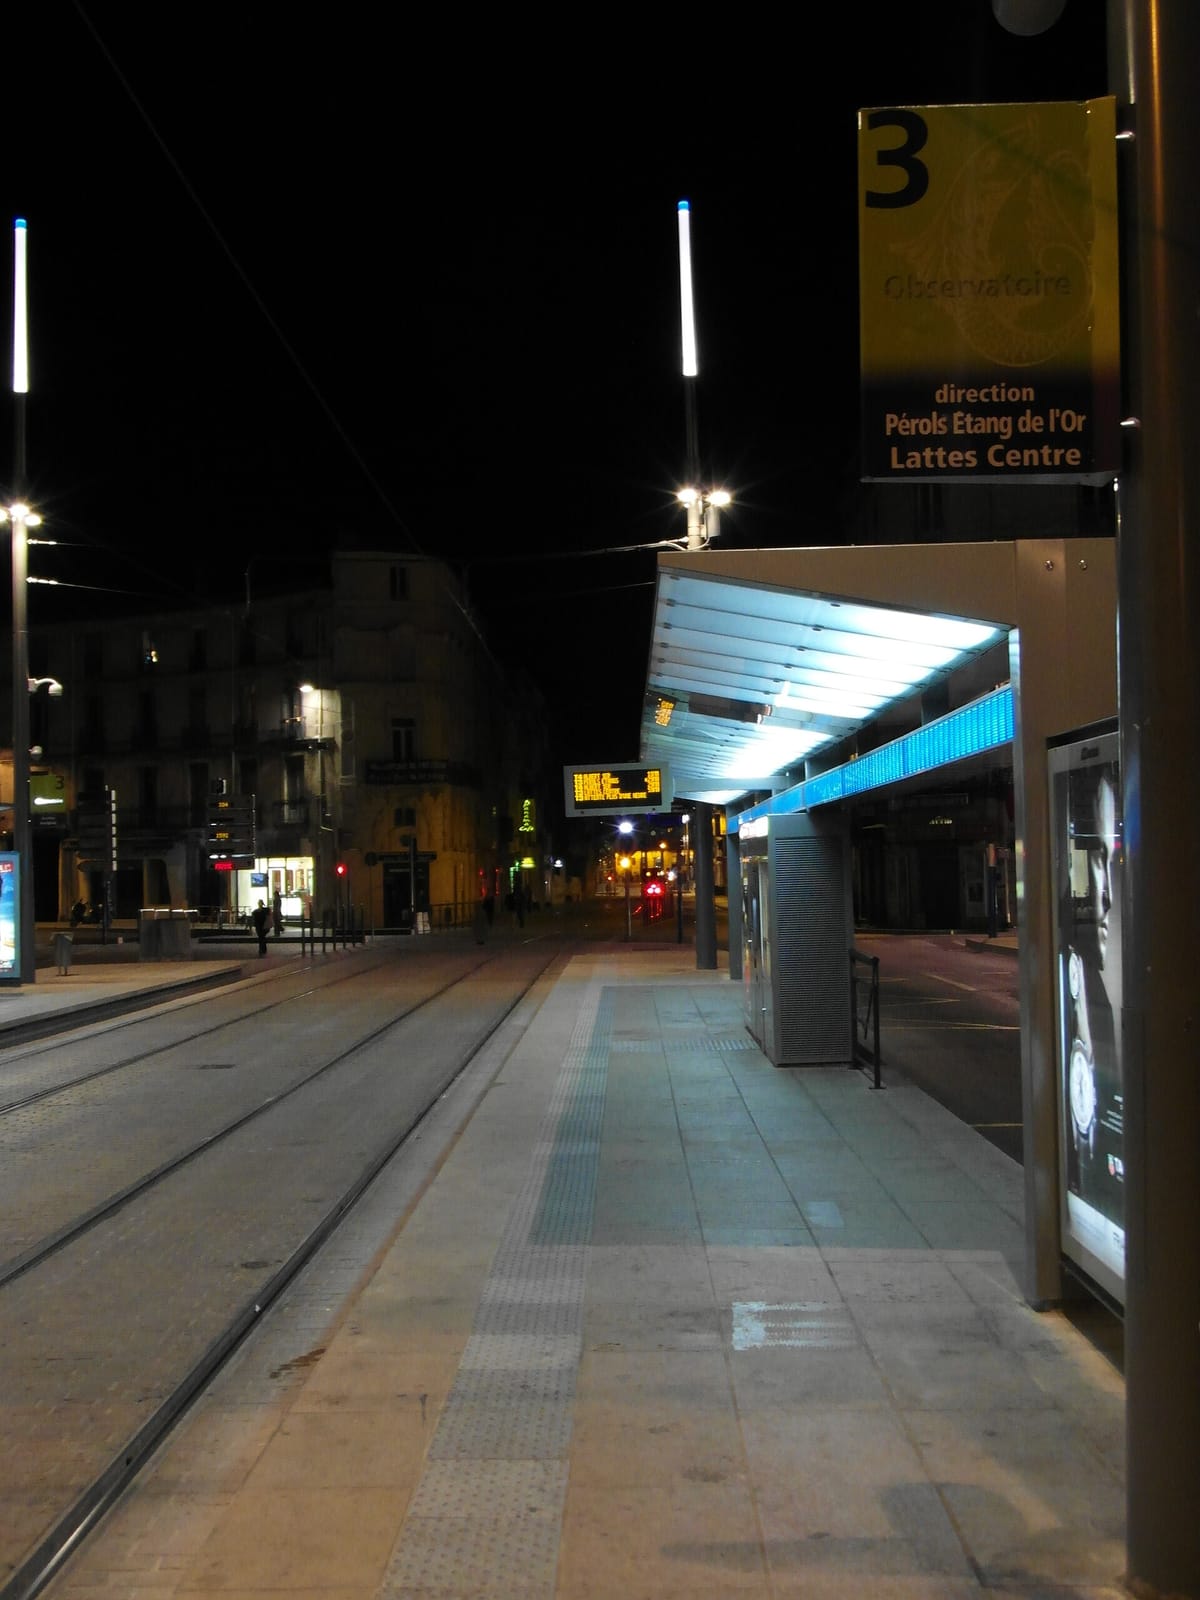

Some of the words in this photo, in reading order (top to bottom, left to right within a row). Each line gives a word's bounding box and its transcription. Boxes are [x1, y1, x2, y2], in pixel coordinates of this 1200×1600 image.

[865, 109, 930, 209] 3
[884, 271, 1072, 299] Observatoire
[935, 383, 1035, 404] direction
[885, 411, 948, 436] Pérols
[1017, 409, 1045, 433] de
[1049, 408, 1087, 432] l'Or
[890, 447, 978, 469] Lattes
[987, 444, 1081, 467] Centre
[55, 775, 65, 790] 3
